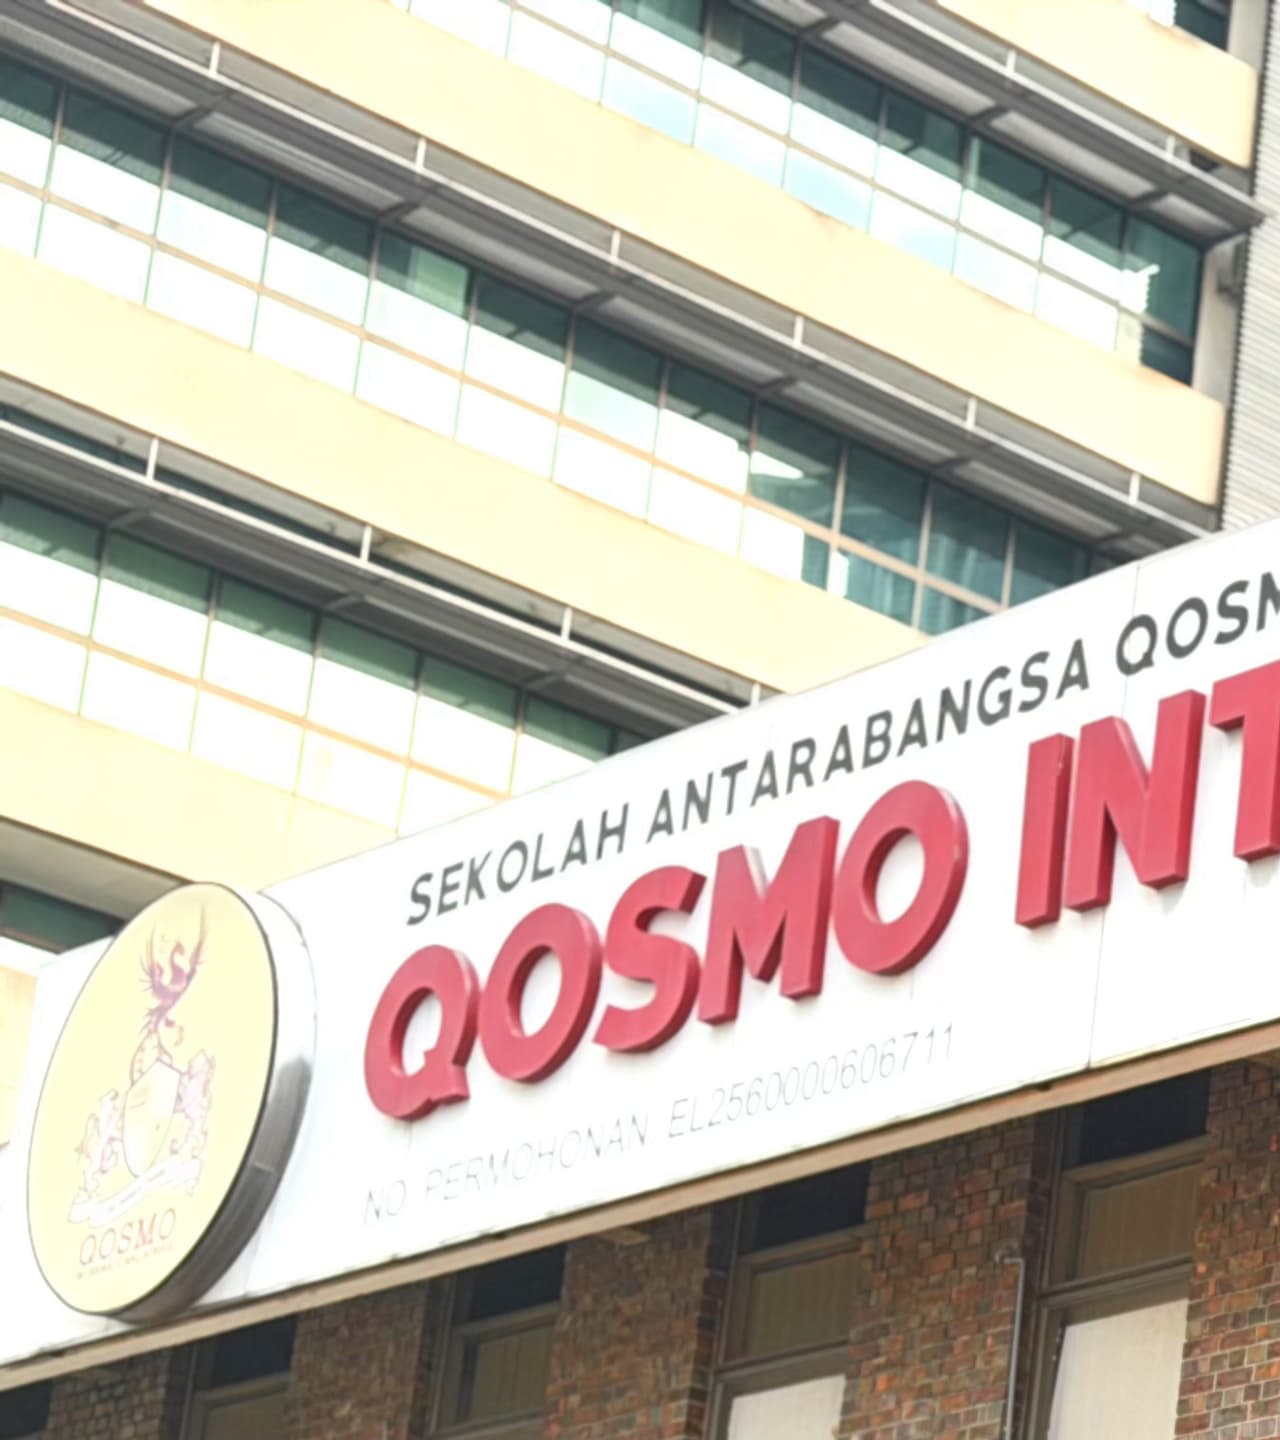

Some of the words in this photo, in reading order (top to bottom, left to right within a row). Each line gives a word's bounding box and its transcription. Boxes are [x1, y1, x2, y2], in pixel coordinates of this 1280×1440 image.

[405, 797, 629, 926] SEKOLAH
[645, 637, 1091, 847] ANTARABANGSA
[364, 782, 970, 1121] QOSMO
[79, 1207, 177, 1266] QOSMO
[363, 1180, 407, 1224] NO
[424, 1114, 649, 1201] PERMOHONAN
[668, 1023, 953, 1138] EL2560000606711
